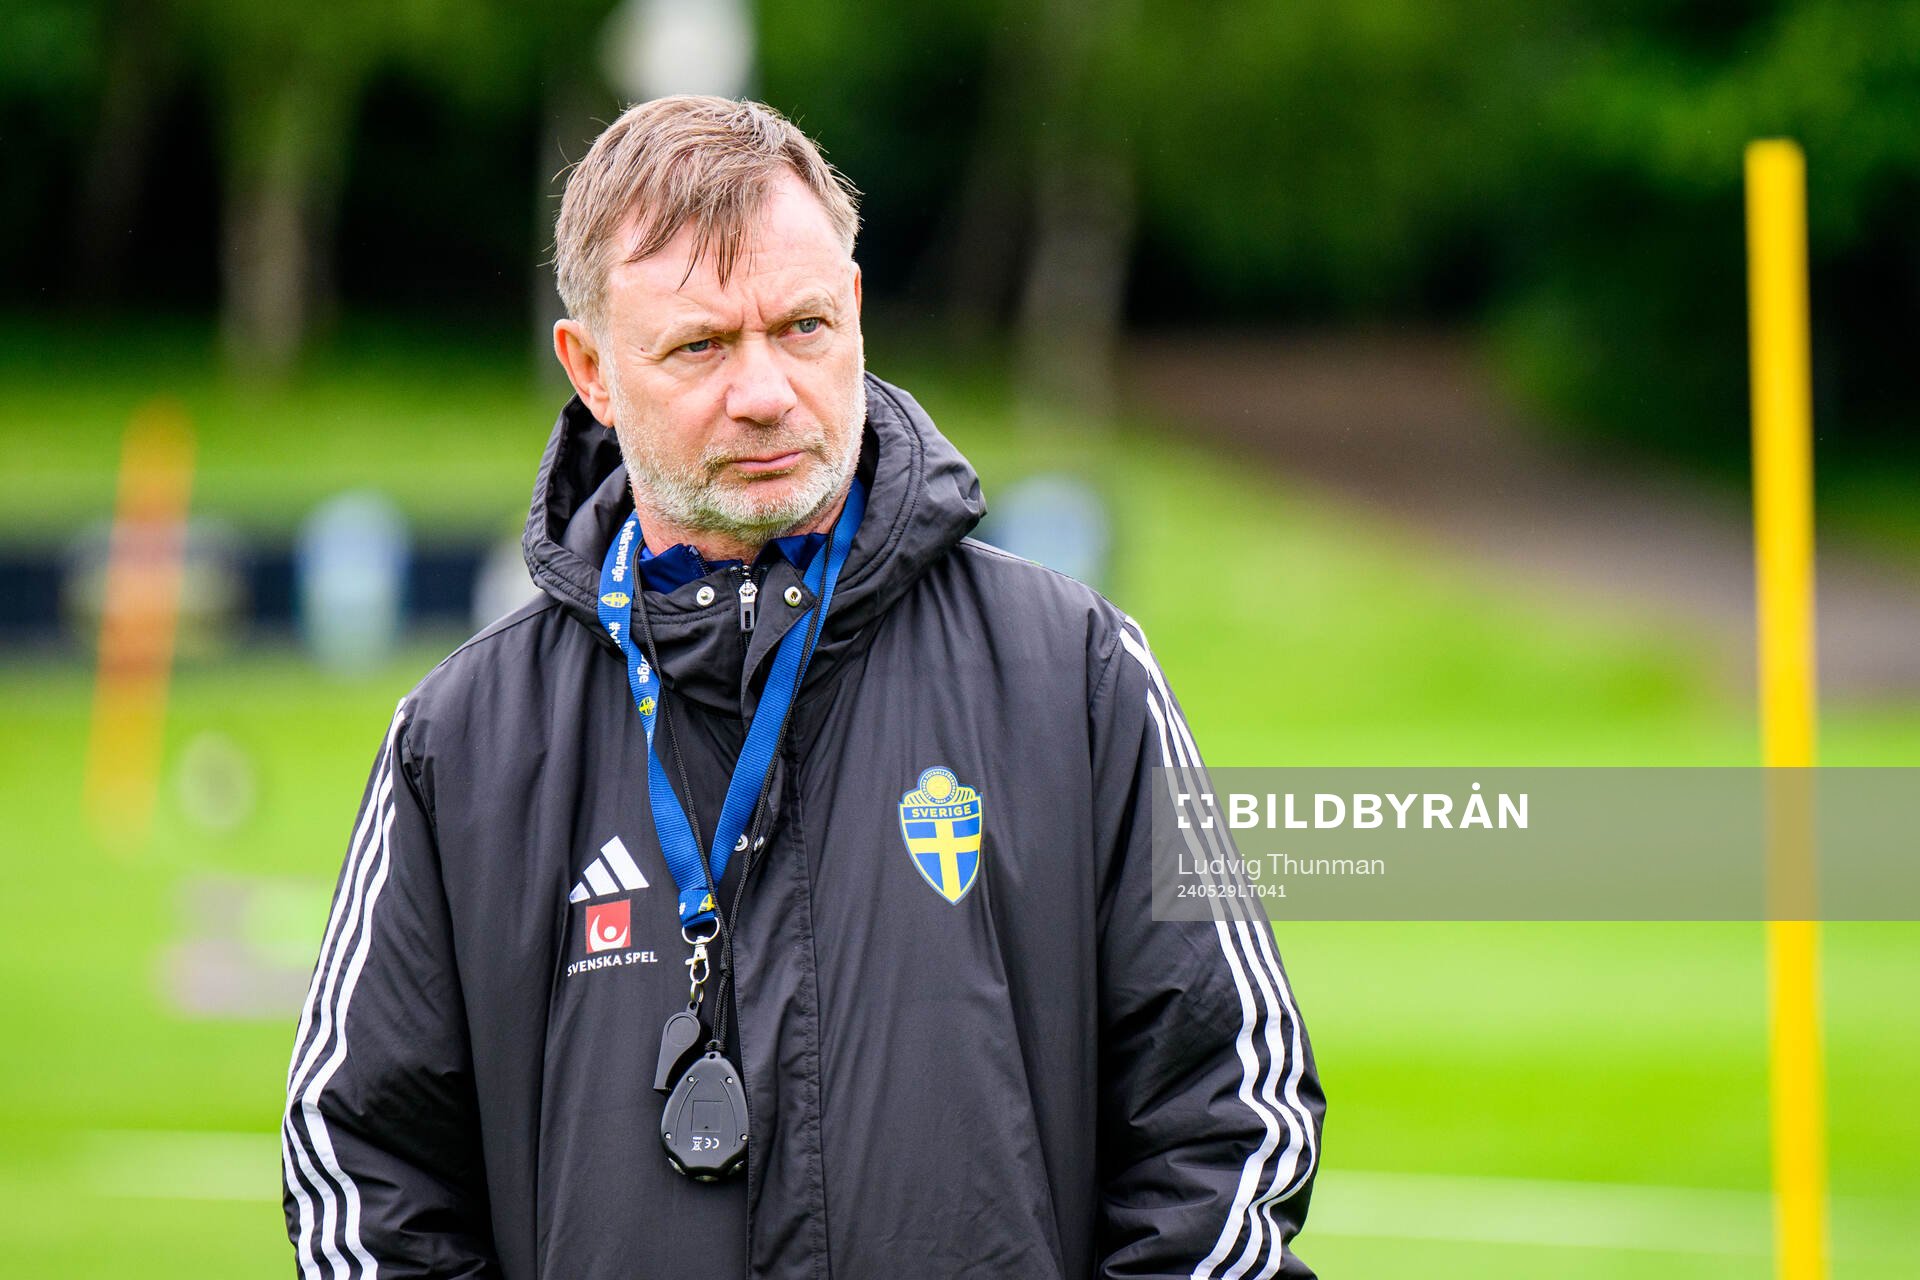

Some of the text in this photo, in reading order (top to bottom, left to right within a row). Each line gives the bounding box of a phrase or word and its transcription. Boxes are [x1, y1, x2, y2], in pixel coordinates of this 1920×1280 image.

[912, 805, 971, 817] SVERIGE
[567, 951, 658, 977] SVENSKA SPEL
